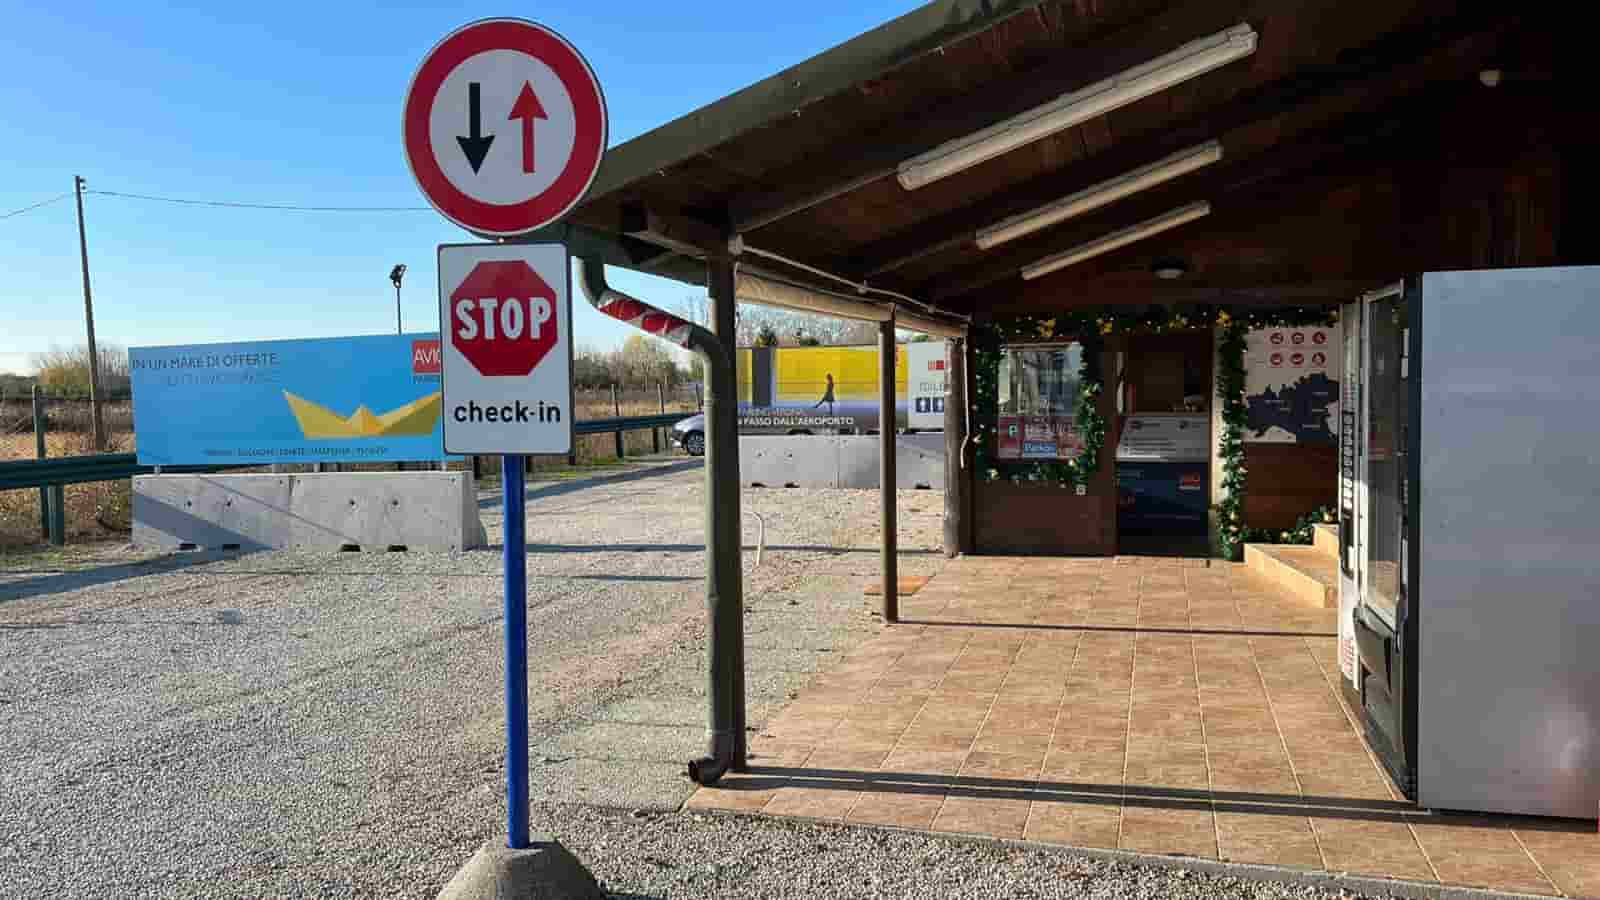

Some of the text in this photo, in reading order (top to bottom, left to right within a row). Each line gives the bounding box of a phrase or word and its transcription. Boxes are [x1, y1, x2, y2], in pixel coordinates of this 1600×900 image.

[455, 297, 553, 341] STOP
[222, 352, 277, 367] OFFERTE
[453, 400, 561, 423] check-in
